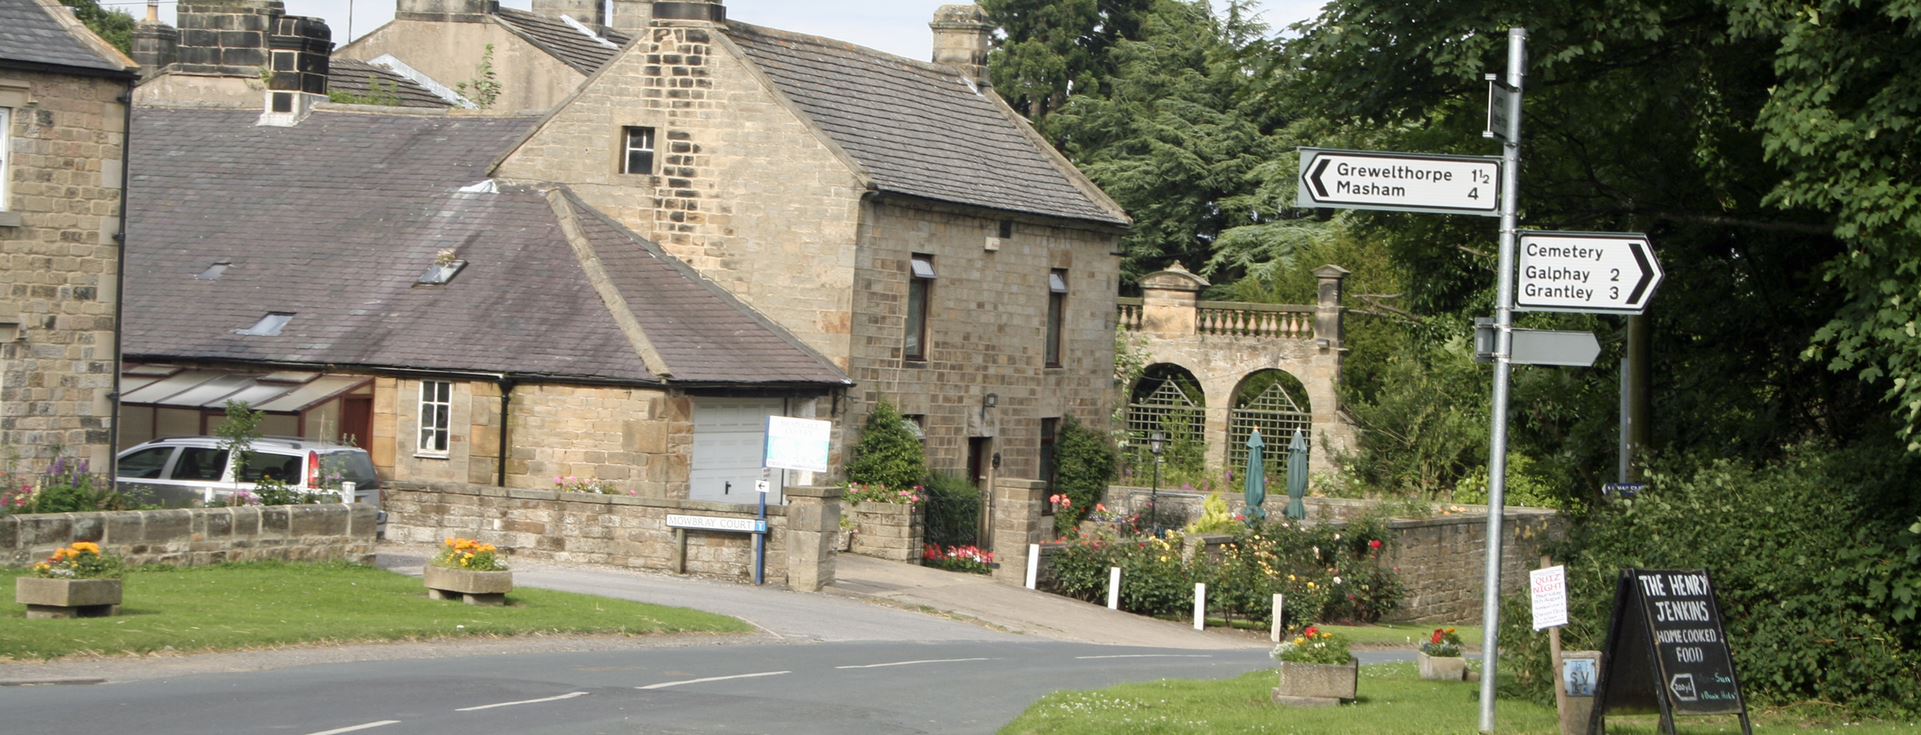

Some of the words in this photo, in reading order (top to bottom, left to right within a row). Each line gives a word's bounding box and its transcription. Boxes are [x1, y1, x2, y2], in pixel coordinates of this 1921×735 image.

[1337, 163, 1453, 181] Grewelthorpe
[1336, 181, 1406, 197] Masham
[1467, 187, 1479, 201] 4
[1526, 243, 1603, 261] Cemetery
[1526, 266, 1590, 282] Galphay
[1609, 268, 1620, 282] 2
[1524, 283, 1593, 301] Grantley
[1609, 286, 1619, 300] 3
[668, 516, 716, 528] MOWBRAY
[719, 520, 753, 530] COURT
[1533, 582, 1562, 594] NIGHT
[1639, 575, 1667, 597] THE
[1671, 574, 1708, 596] HENRY
[1656, 601, 1710, 622] JENKINS
[1676, 647, 1705, 663] FOOD
